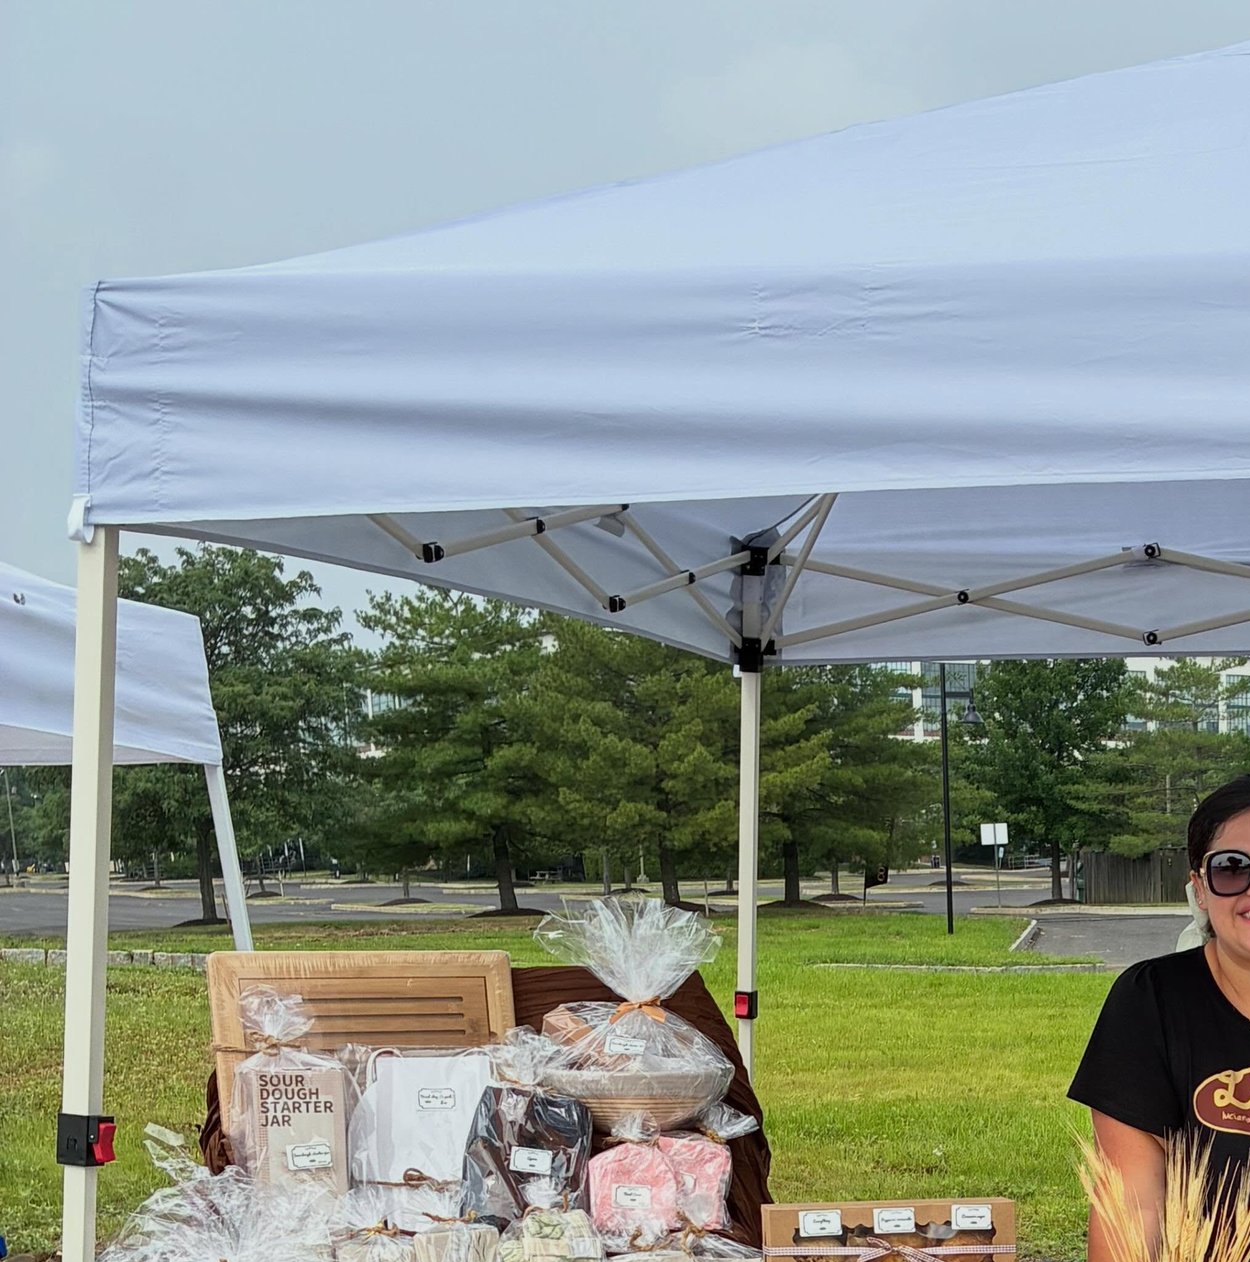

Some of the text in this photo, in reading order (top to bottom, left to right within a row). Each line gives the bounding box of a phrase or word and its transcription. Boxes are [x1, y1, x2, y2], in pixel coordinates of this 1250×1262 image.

[258, 1074, 305, 1087] SOUR
[260, 1088, 320, 1100] DOUGH
[260, 1101, 334, 1114] STARTER
[261, 1115, 292, 1127] JAR
